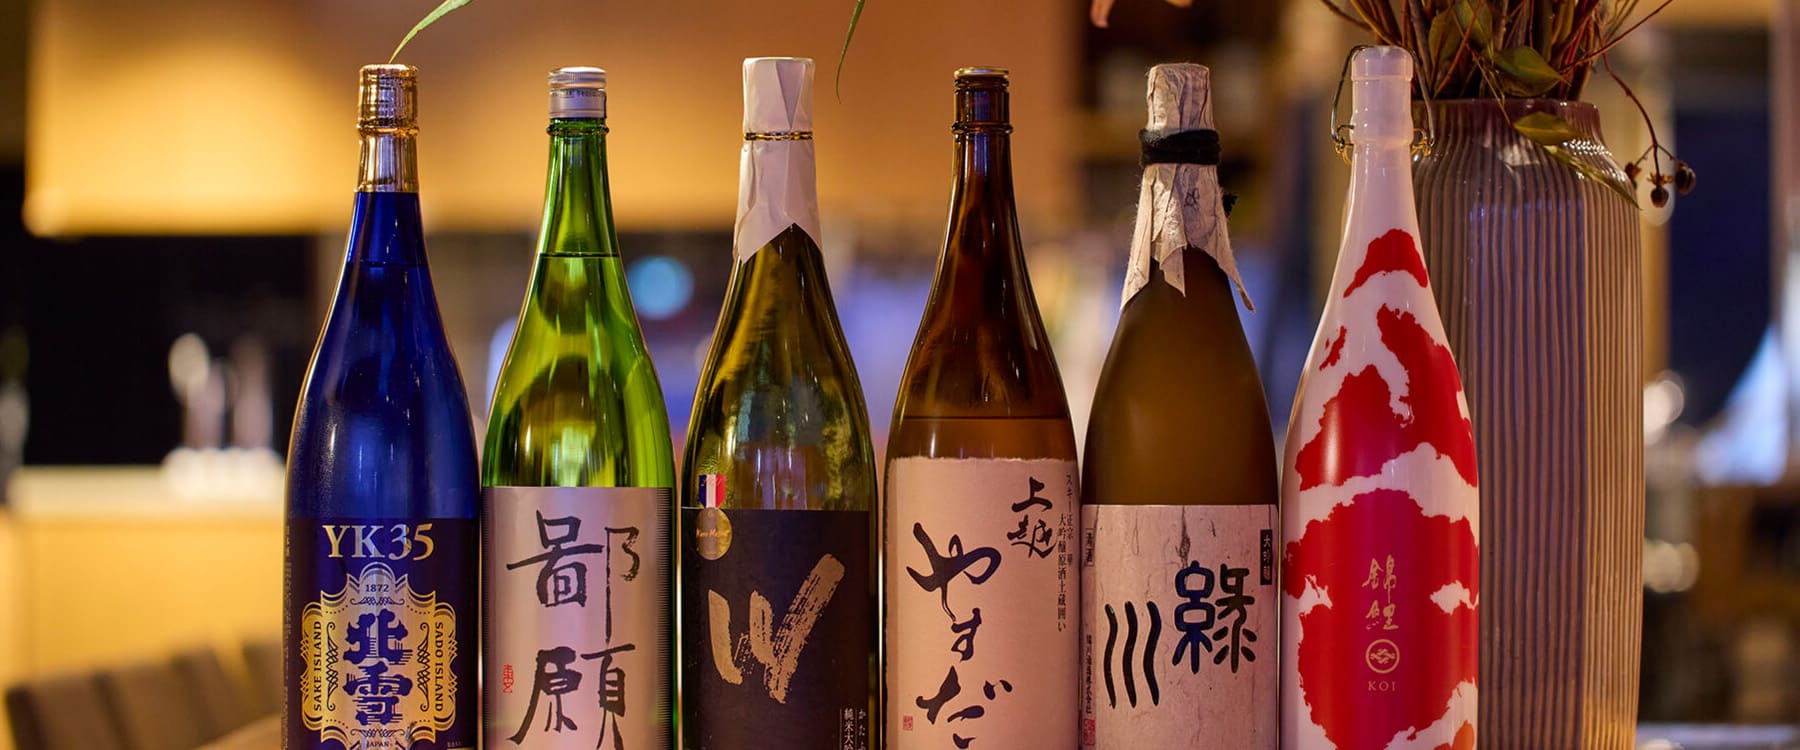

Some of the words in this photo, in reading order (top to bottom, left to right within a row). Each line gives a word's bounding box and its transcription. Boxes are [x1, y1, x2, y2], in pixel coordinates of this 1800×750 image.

[322, 523, 434, 561] YK35
[365, 583, 389, 593] 1872
[313, 621, 322, 671] ISLAND
[435, 622, 444, 658] SADO
[906, 522, 1013, 749] やすだ
[342, 608, 413, 726] 北雪
[1368, 681, 1396, 691] KOI
[313, 676, 322, 711] SAKE
[435, 662, 444, 712] ISLAND
